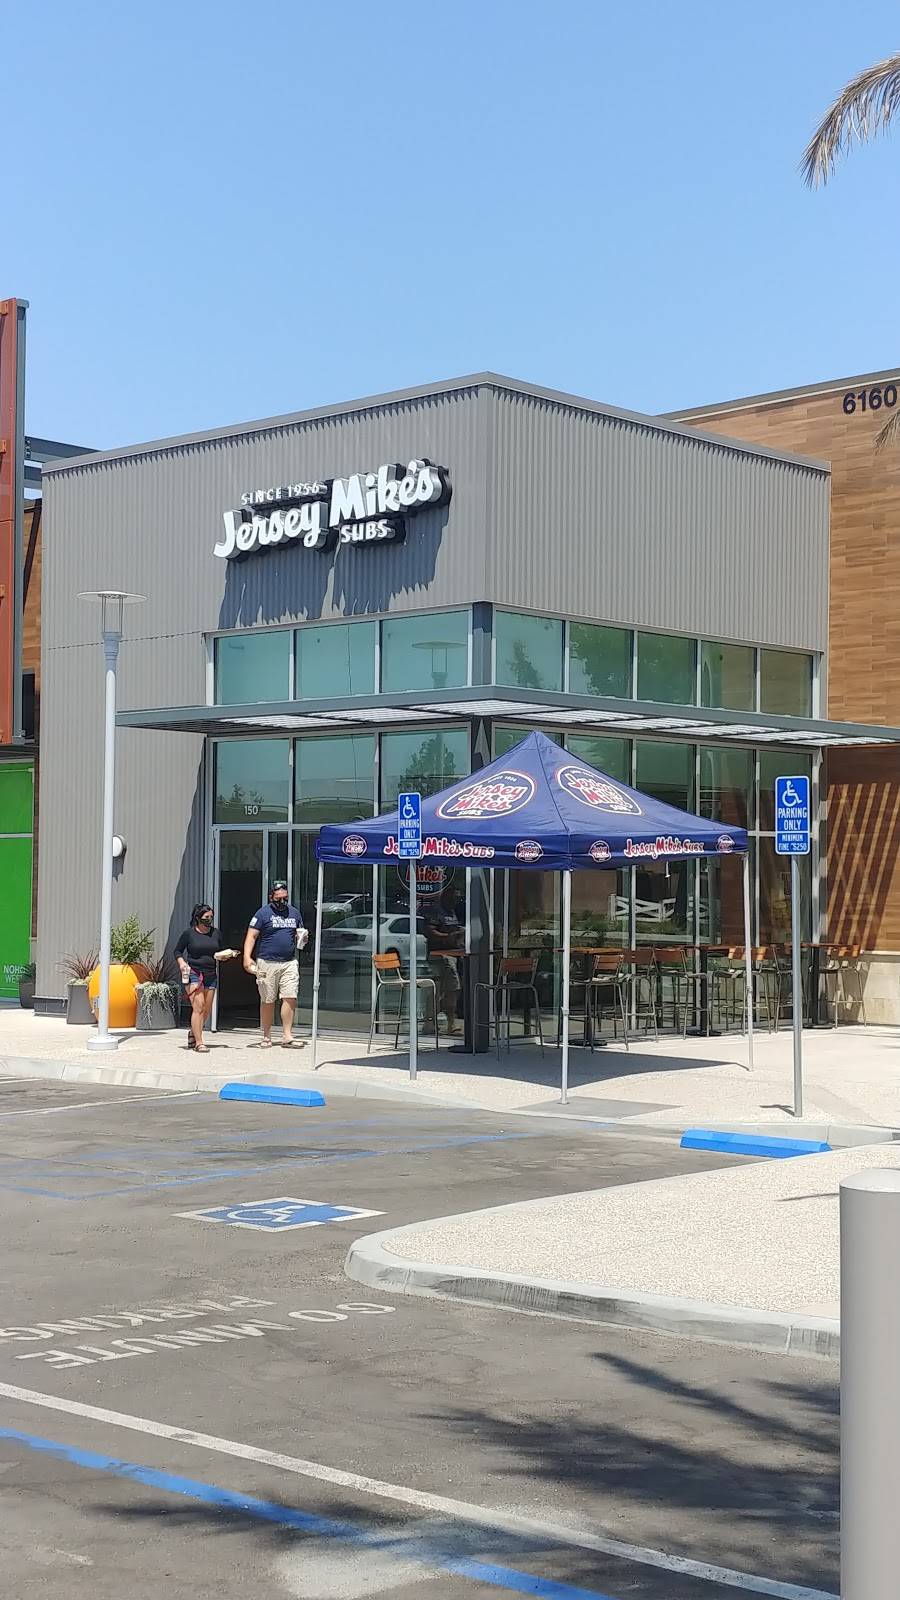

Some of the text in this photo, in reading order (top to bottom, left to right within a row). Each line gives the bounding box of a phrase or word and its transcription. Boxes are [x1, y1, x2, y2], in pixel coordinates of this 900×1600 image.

[842, 384, 898, 415] 6160
[240, 482, 322, 506] SINCE 1956
[213, 458, 438, 559] Jersey Mike's
[340, 518, 392, 544] SUBS
[458, 783, 528, 802] Jersey
[244, 805, 259, 815] 150
[778, 807, 808, 818] PARKING
[403, 829, 417, 839] ONLY
[783, 819, 802, 830] ONLY
[424, 836, 464, 857] Mike's
[778, 842, 790, 850] FINE
[781, 833, 804, 841] MINIMUM
[623, 838, 658, 859] Jersey
[417, 883, 434, 891] SUBS
[0, 1295, 278, 1342] PARKING
[15, 1301, 397, 1370] 60 MINUTE
